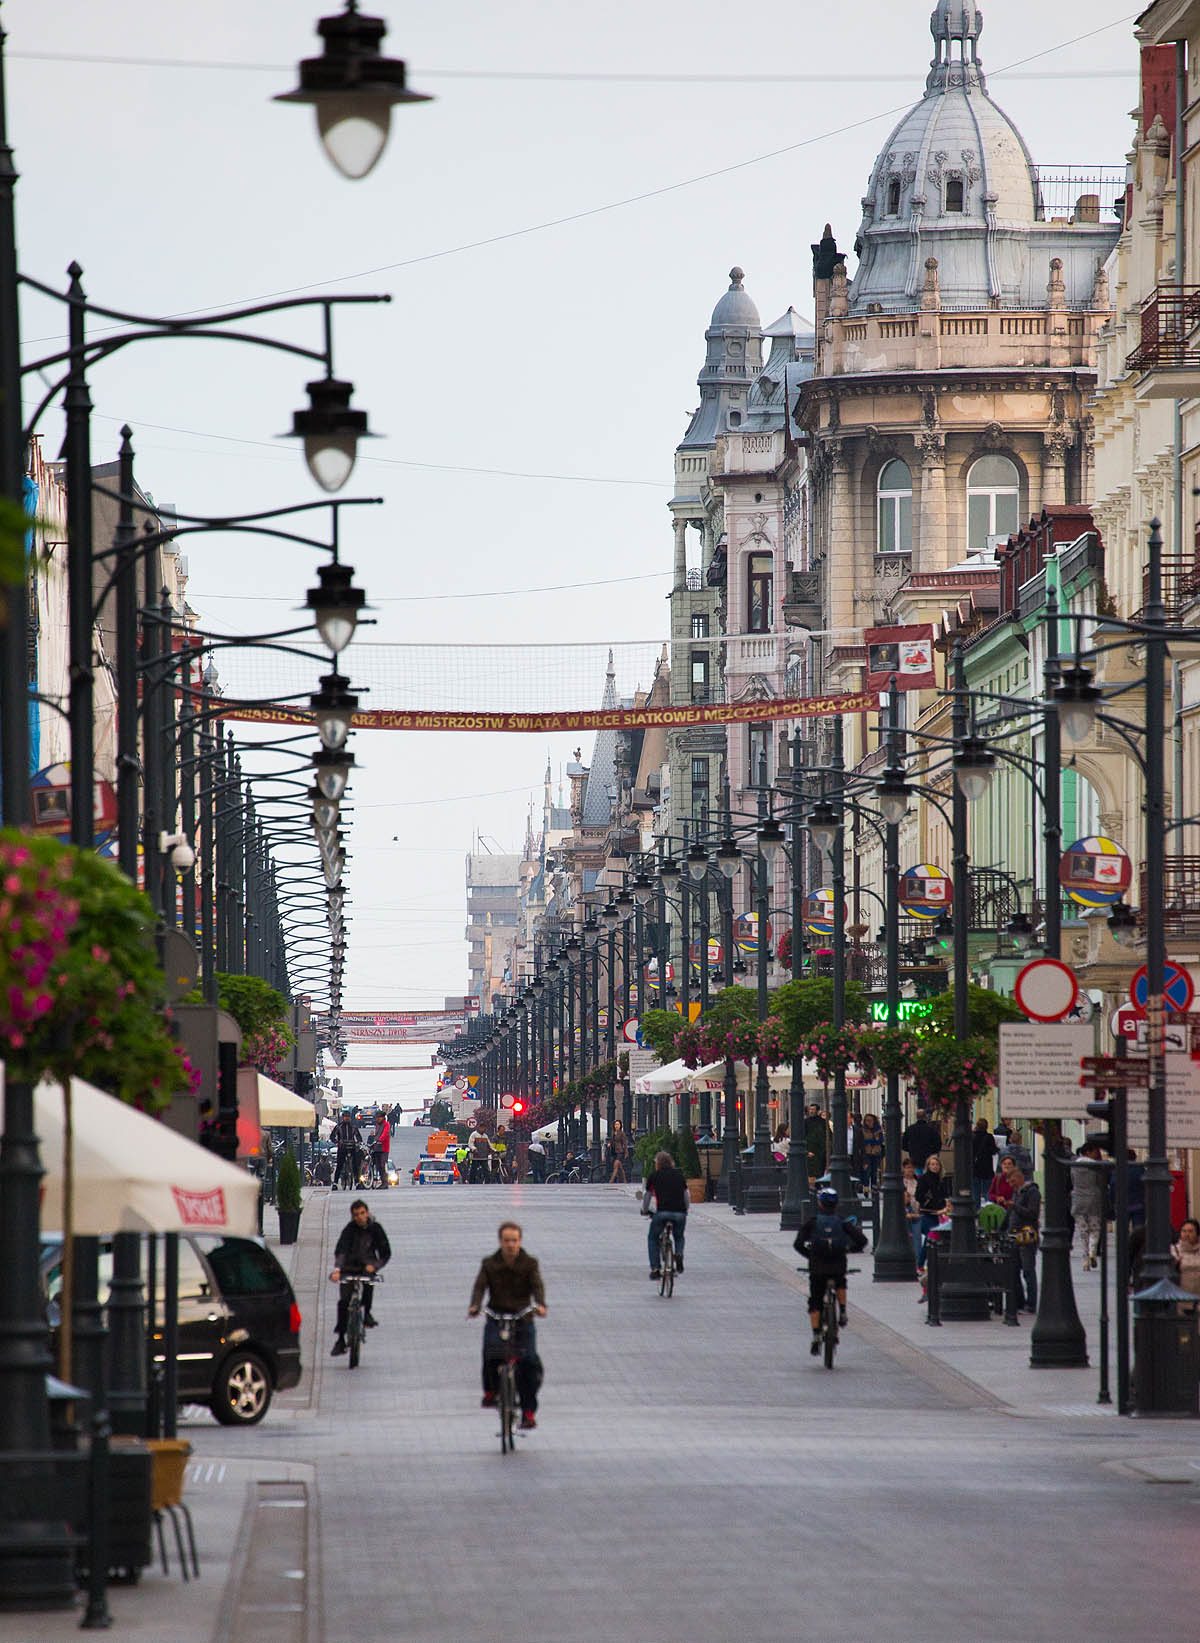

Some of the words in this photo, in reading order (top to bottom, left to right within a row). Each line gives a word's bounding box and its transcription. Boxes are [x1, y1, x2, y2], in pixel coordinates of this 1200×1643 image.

[381, 716, 411, 727] FIVB
[415, 716, 504, 729] MISTRZOSTW
[508, 714, 561, 729] ŚWIATA
[566, 716, 580, 727] W
[583, 714, 620, 727] PIŁCE
[623, 711, 700, 725] SIATKOWEJ
[704, 705, 778, 722] MĘŻCZYZN
[783, 701, 837, 715] POLSKA
[840, 697, 873, 710] 2014
